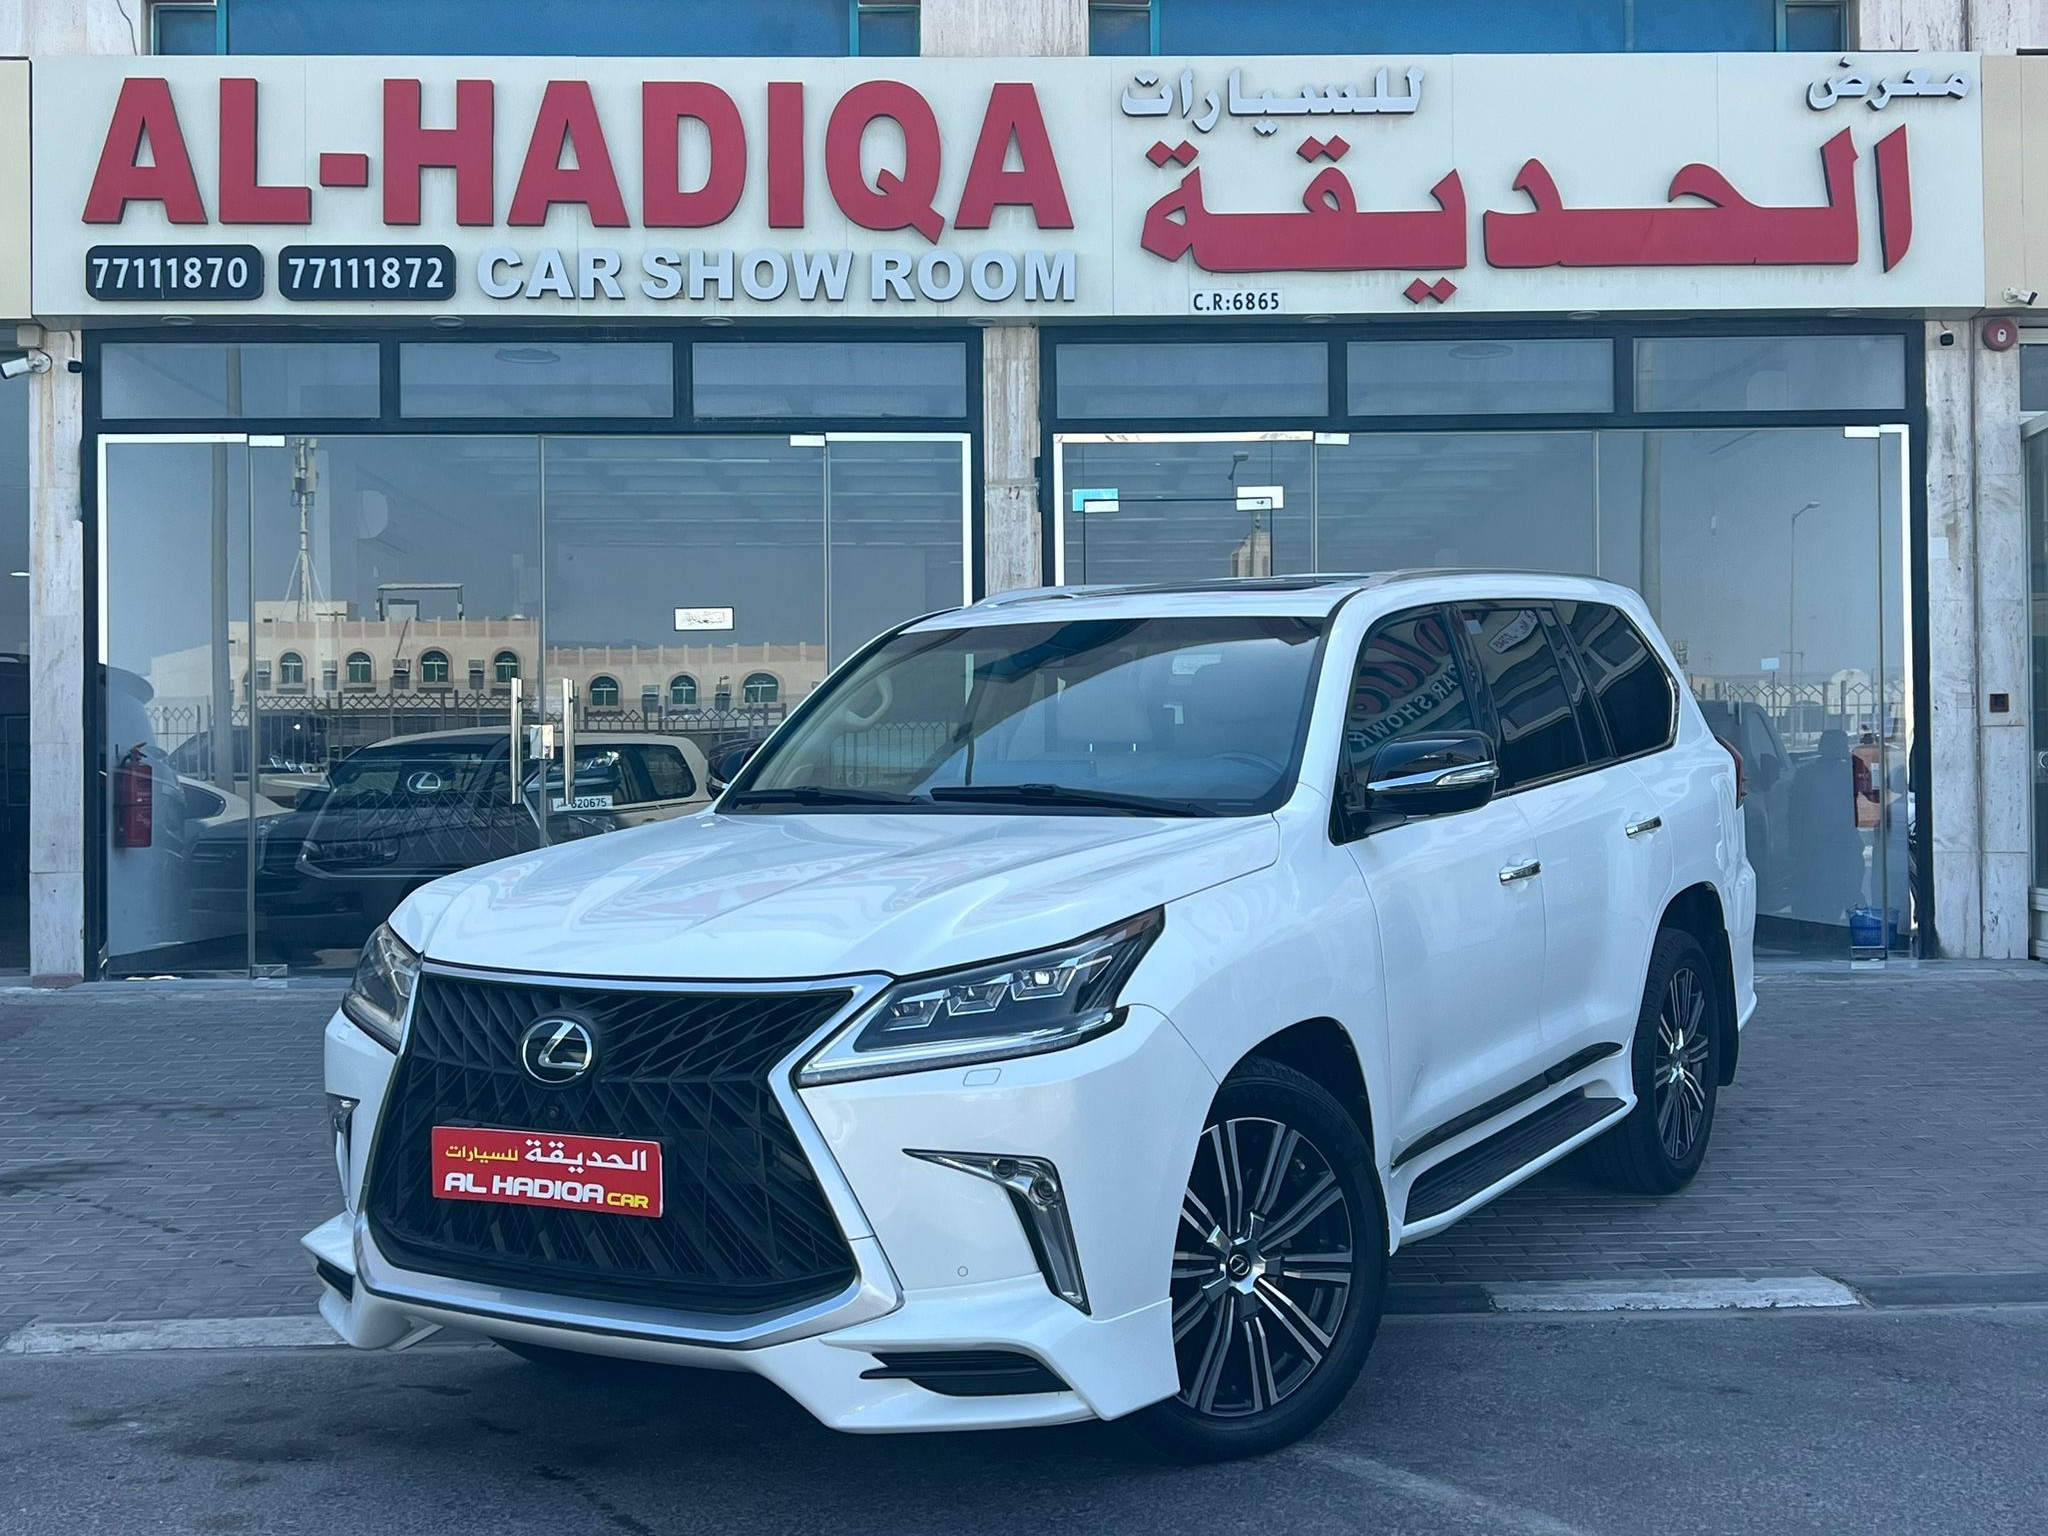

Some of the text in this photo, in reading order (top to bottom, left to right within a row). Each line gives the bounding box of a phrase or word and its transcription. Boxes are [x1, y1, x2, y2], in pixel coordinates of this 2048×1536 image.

[1121, 65, 1425, 136] للسيارات
[1806, 57, 1971, 111] معرض
[82, 77, 1074, 244] AL-HADIQA
[1141, 123, 1913, 304] الحديقة
[92, 256, 249, 290] 77111870
[287, 256, 445, 290] 77111872
[477, 247, 1076, 303] CAR SHOW ROOM
[1193, 292, 1280, 311] C.R:6865
[444, 1138, 648, 1174] الحديقة للسيارات
[444, 1171, 649, 1210] AL HADIQA CAR
